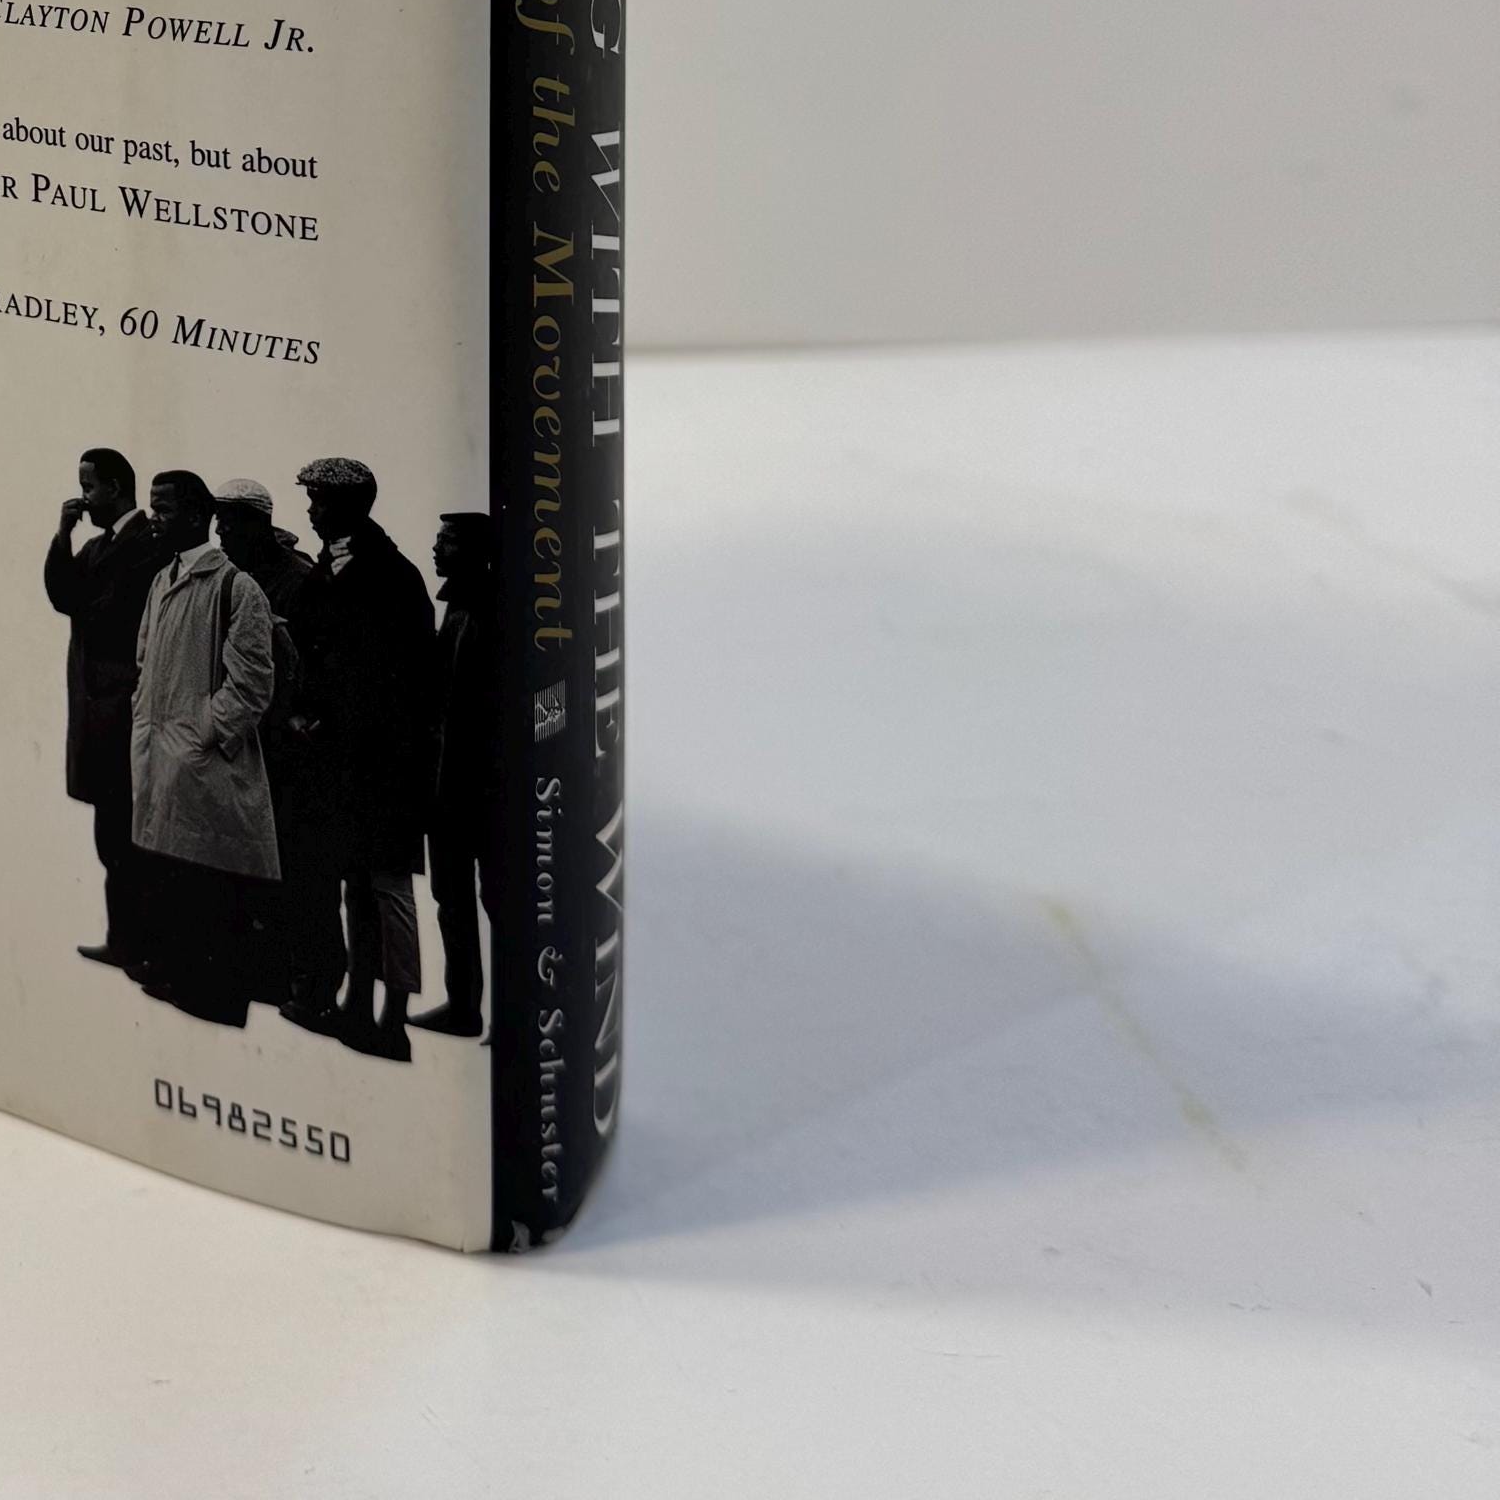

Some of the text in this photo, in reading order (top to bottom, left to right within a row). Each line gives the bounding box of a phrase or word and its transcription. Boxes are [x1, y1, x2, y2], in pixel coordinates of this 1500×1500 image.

[122, 5, 250, 47] POWELL
[264, 19, 313, 52] JR.
[2, 117, 67, 148] about
[75, 133, 115, 154] our
[122, 139, 179, 168] past,
[189, 140, 232, 170] but
[241, 147, 318, 179] about
[532, 74, 576, 194] the
[30, 173, 106, 212] PAUL
[117, 186, 319, 241] WELLSTONE
[120, 307, 159, 339] 60
[171, 315, 320, 364] MINUTES
[532, 221, 575, 653] Movement
[535, 777, 566, 1202] Simon & Schuster
[154, 1078, 351, 1163] 06982550
